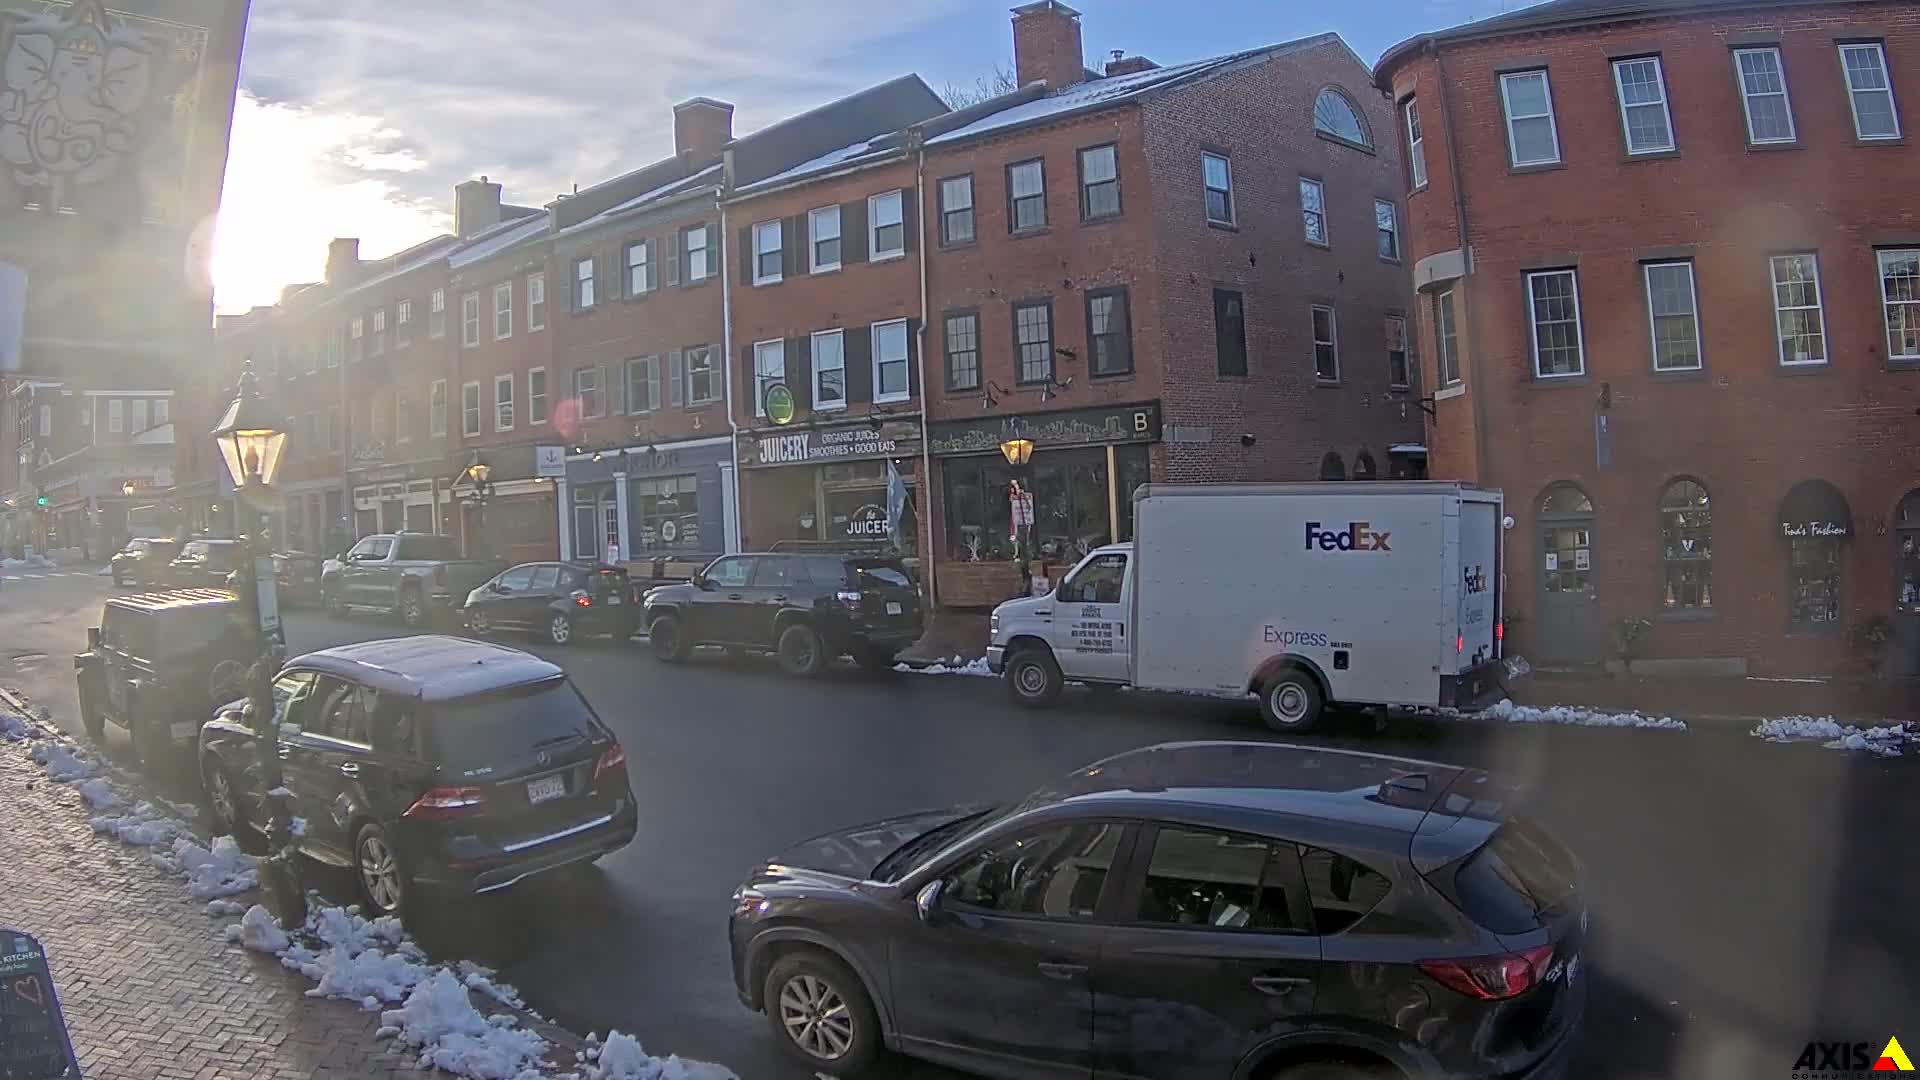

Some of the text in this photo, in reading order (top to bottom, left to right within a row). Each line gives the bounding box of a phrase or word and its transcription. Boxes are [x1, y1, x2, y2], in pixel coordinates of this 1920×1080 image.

[1134, 412, 1148, 431] B
[822, 430, 880, 444] ORGANIC JUICES
[760, 434, 809, 463] JUICERY
[809, 440, 896, 458] SMOOTHIES GOOD EATS
[846, 520, 889, 535] JUICER
[1305, 522, 1391, 551] FedEx
[1264, 624, 1328, 648] Express
[3, 951, 41, 963] KITCHEN
